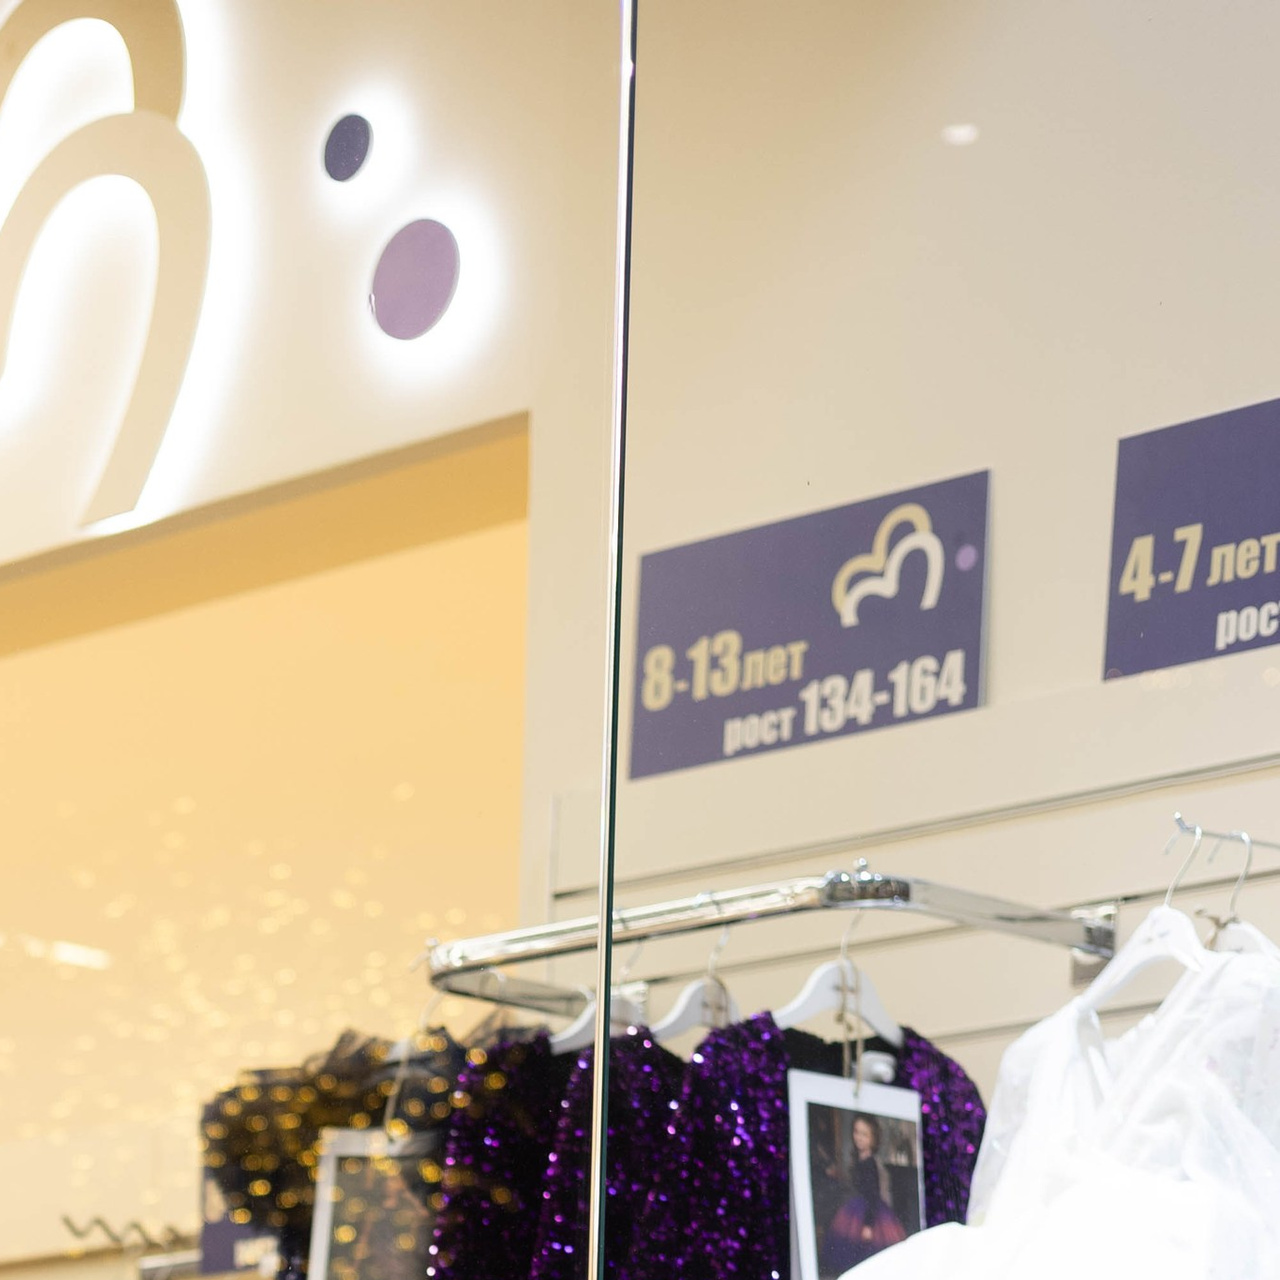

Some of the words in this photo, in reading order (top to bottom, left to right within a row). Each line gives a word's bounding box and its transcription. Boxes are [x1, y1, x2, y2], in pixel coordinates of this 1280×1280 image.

[1118, 522, 1204, 603] 4-7
[1205, 532, 1280, 587] лет
[1215, 600, 1280, 651] рос
[722, 705, 797, 757] рост
[798, 648, 966, 736] 134-164
